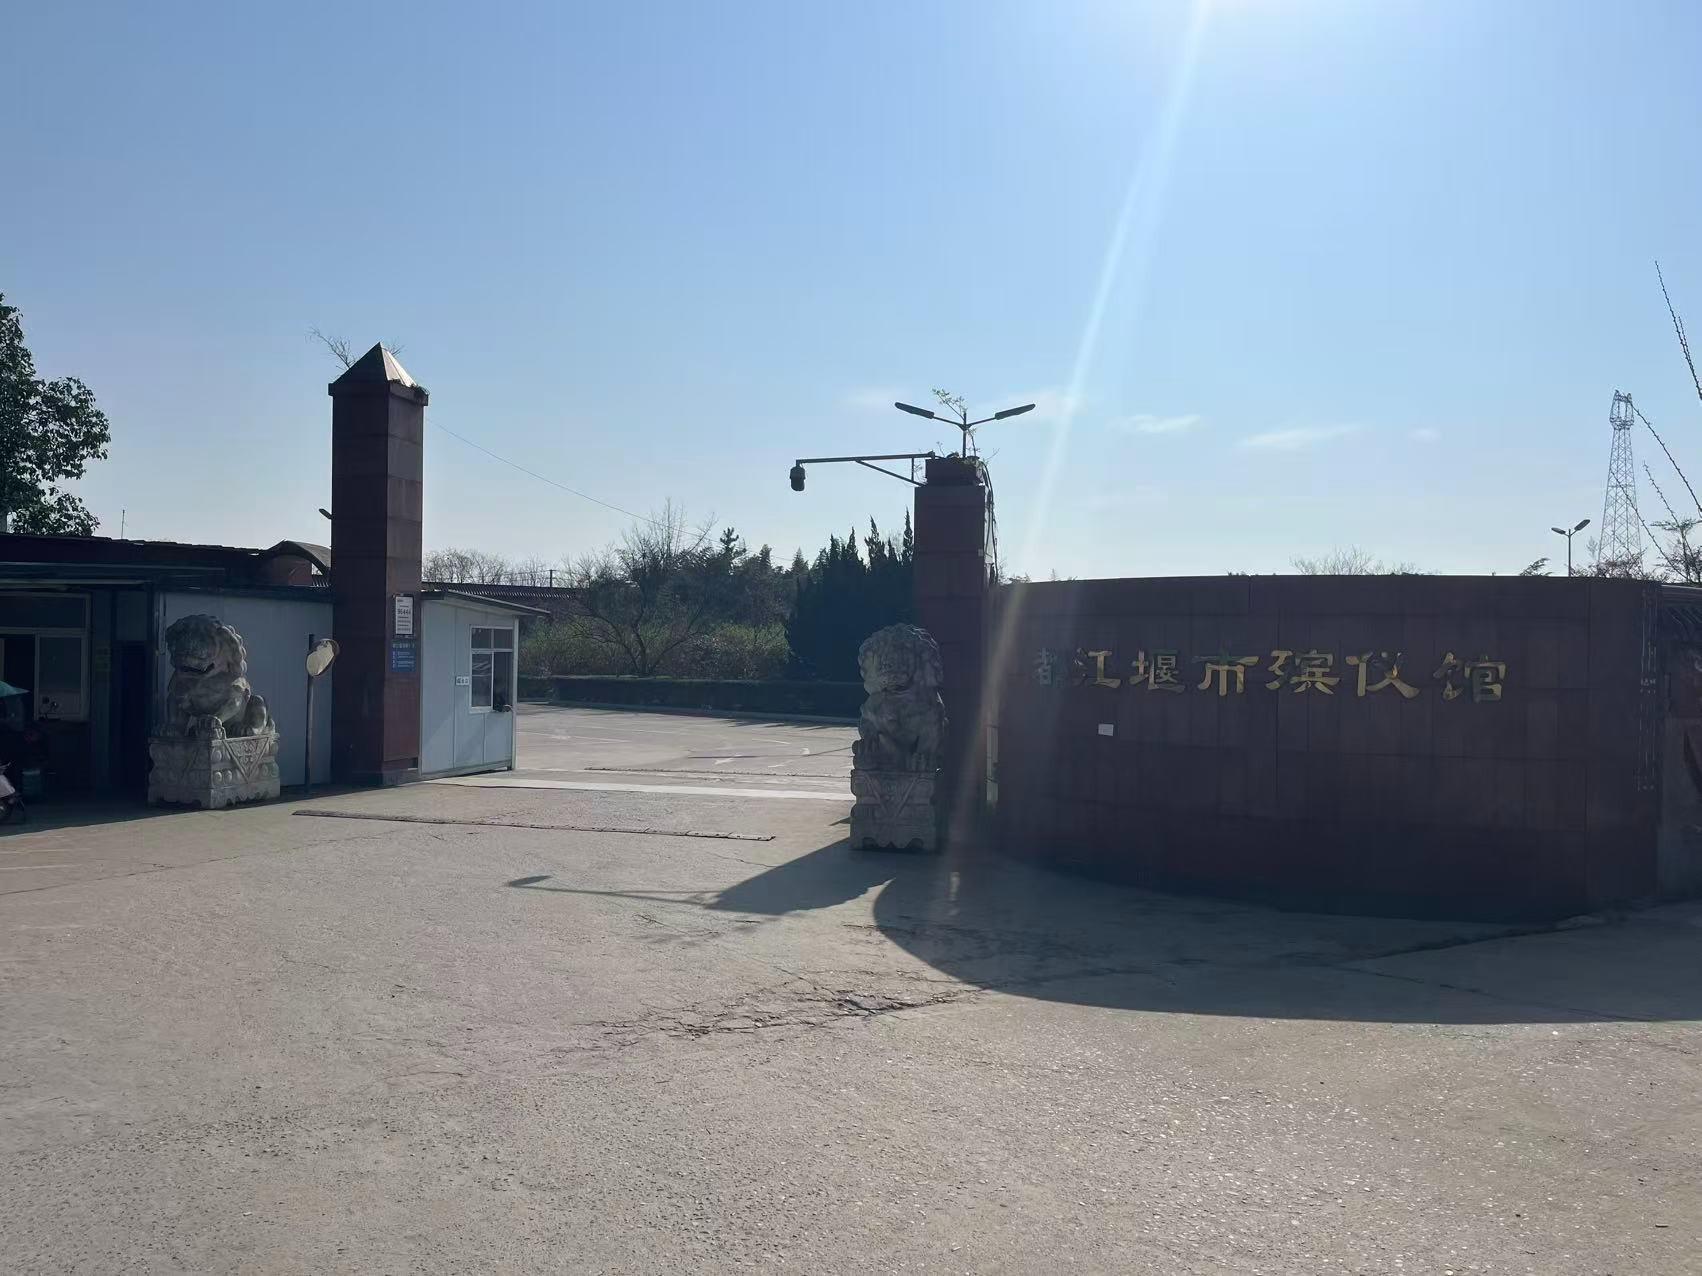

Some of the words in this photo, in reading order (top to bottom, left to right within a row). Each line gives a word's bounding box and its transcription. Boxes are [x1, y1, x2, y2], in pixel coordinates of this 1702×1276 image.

[1034, 647, 1507, 703] 都江堰市殡仪馆
